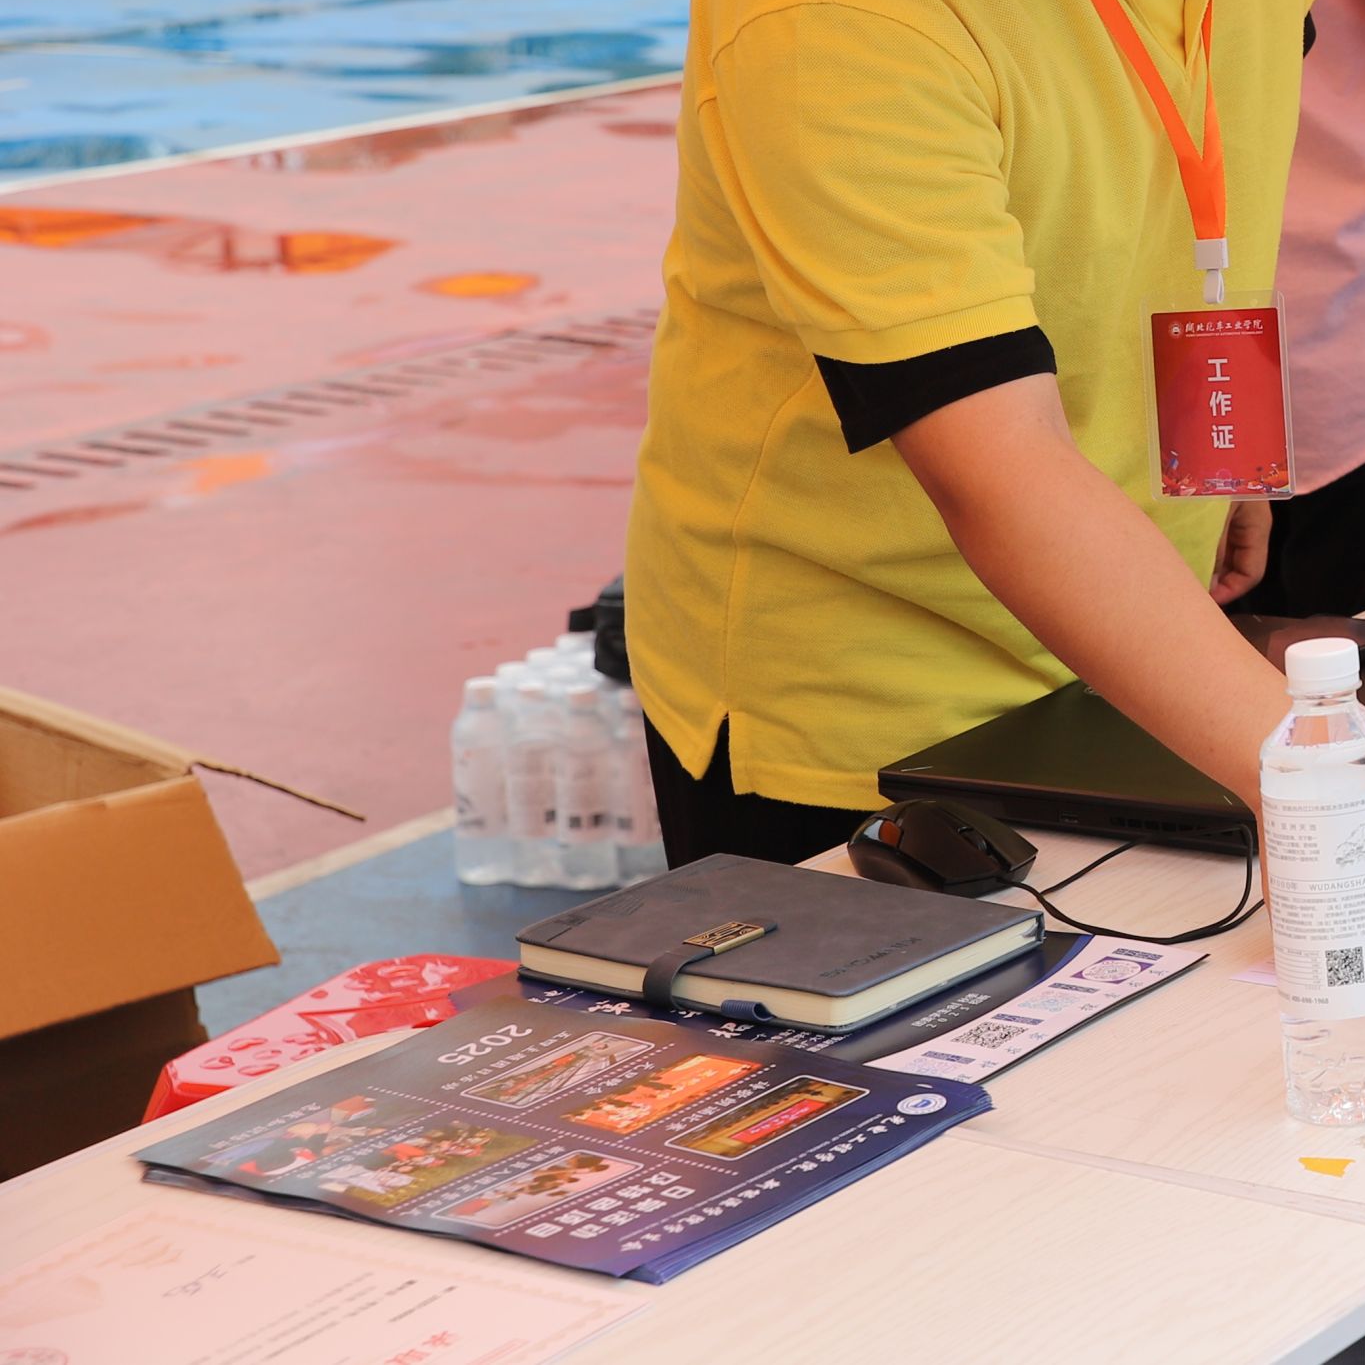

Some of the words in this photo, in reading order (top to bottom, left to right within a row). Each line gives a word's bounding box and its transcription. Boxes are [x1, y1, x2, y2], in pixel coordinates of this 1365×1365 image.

[1207, 357, 1236, 450] 工作证
[429, 1022, 538, 1068] 2025
[575, 1060, 661, 1097] 元旦晚会
[516, 1170, 684, 1239] 及特色项目
